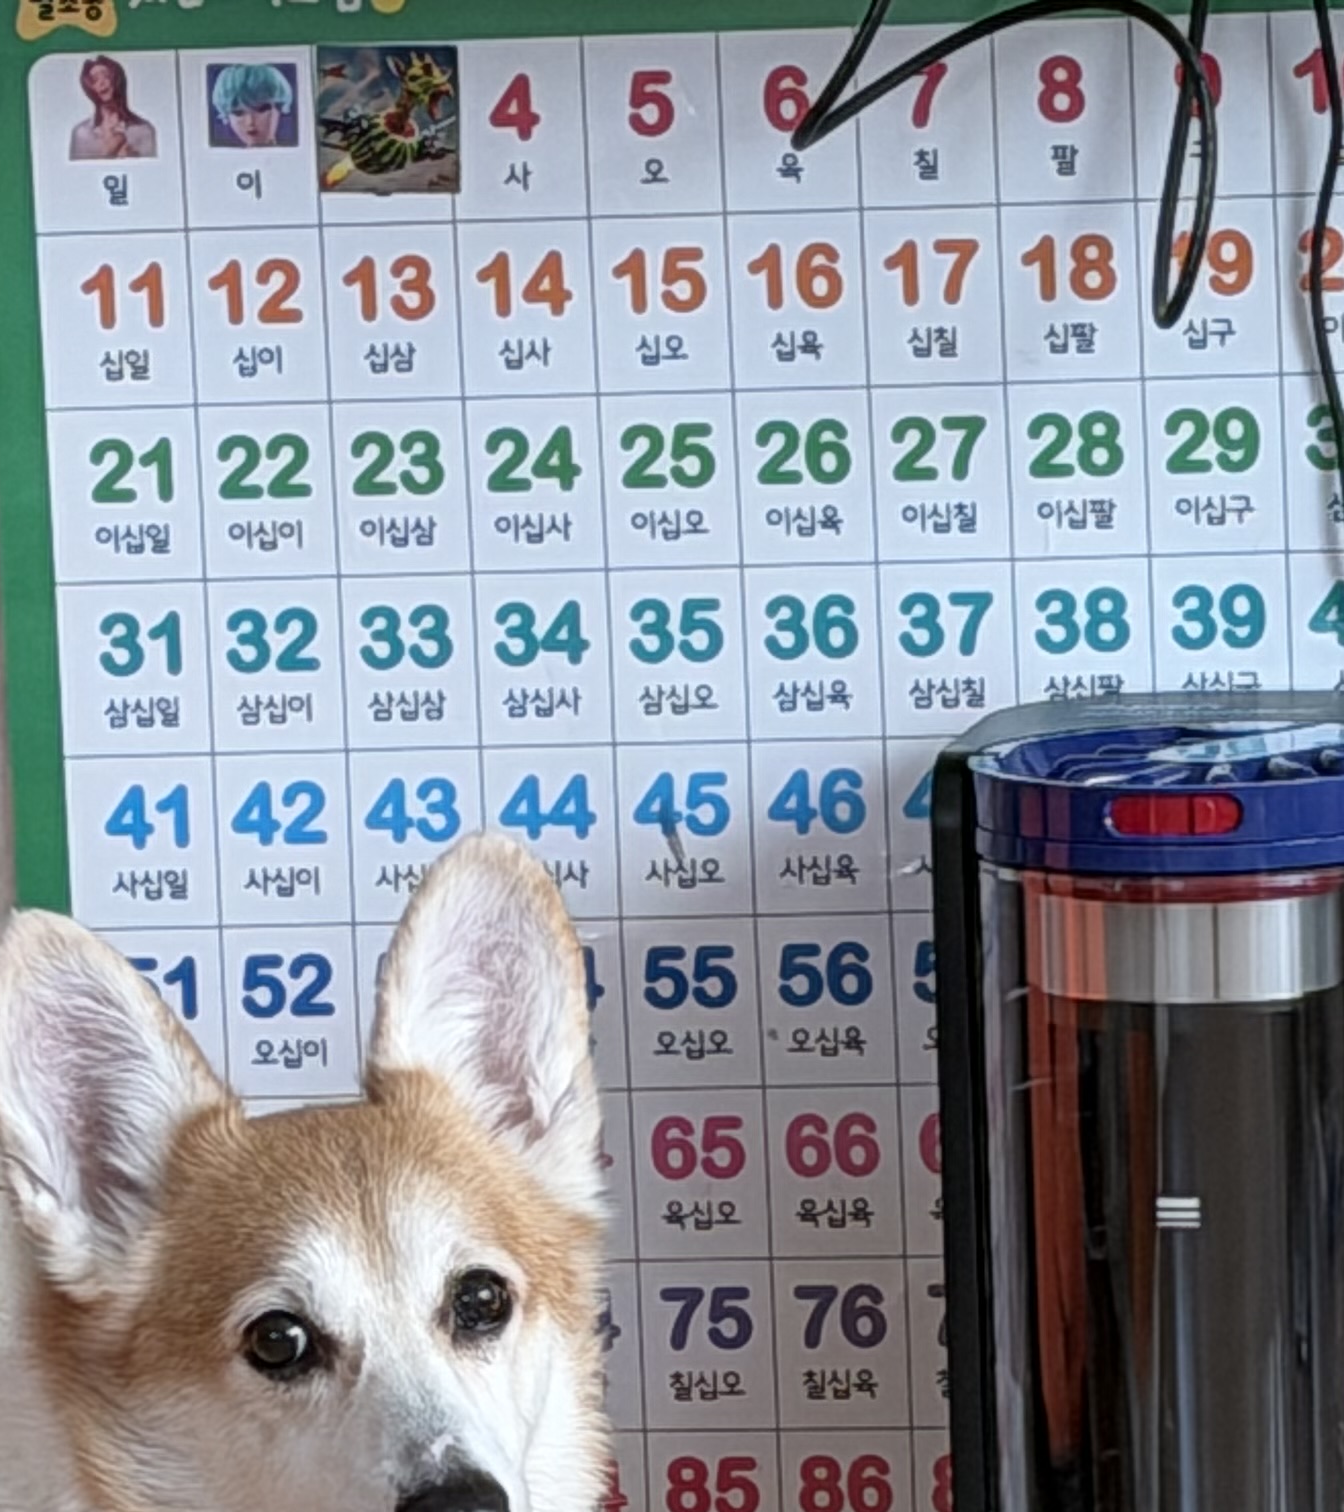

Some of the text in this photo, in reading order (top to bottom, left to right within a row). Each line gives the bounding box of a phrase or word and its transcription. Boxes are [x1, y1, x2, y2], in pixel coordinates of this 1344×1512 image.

[489, 73, 540, 141] 4
[628, 70, 674, 136] 5
[763, 65, 811, 132] 6
[1038, 55, 1085, 124] 8
[102, 144, 1078, 206] 일 이 사 오 육 칠 팔
[80, 233, 1116, 330] 11 12 13 14 15 16 17 18
[99, 349, 151, 381] 십일
[233, 345, 284, 378] 십이
[364, 342, 416, 374] 십삼
[499, 337, 552, 370] 십사
[636, 334, 688, 366] 십오
[770, 330, 824, 362] 십육
[907, 325, 959, 359] 십칠
[1043, 321, 1099, 355] 십팔
[1183, 318, 1236, 350] 십구
[89, 406, 1261, 503] 21 22 23 24 25 26 27 28 29
[95, 494, 1255, 555] 이십일 이십이 이십삼 이십사 이십오 이십육 이십칠 이십팔 이십구
[99, 582, 1267, 677] 31 32 33 34 35 36 37 38 39
[104, 696, 181, 729] 삼십일
[237, 693, 313, 726] 삼십이
[503, 686, 581, 718] 삼십사
[638, 683, 719, 716] 삼십오
[773, 680, 853, 712] 삼십육
[909, 676, 986, 710] 삼십칠
[104, 768, 866, 850] 41 42 43 44 45 46
[112, 853, 860, 900] 사십일 사십이 사십오 사십육
[241, 942, 873, 1019] 52 55 56
[251, 1026, 867, 1069] 오십이 오십오 오십육
[651, 1112, 881, 1180] 65 66
[662, 1197, 875, 1231] 육십오 육십육
[660, 1283, 888, 1351] 75 76
[669, 1368, 879, 1401] 칠십오 칠십육
